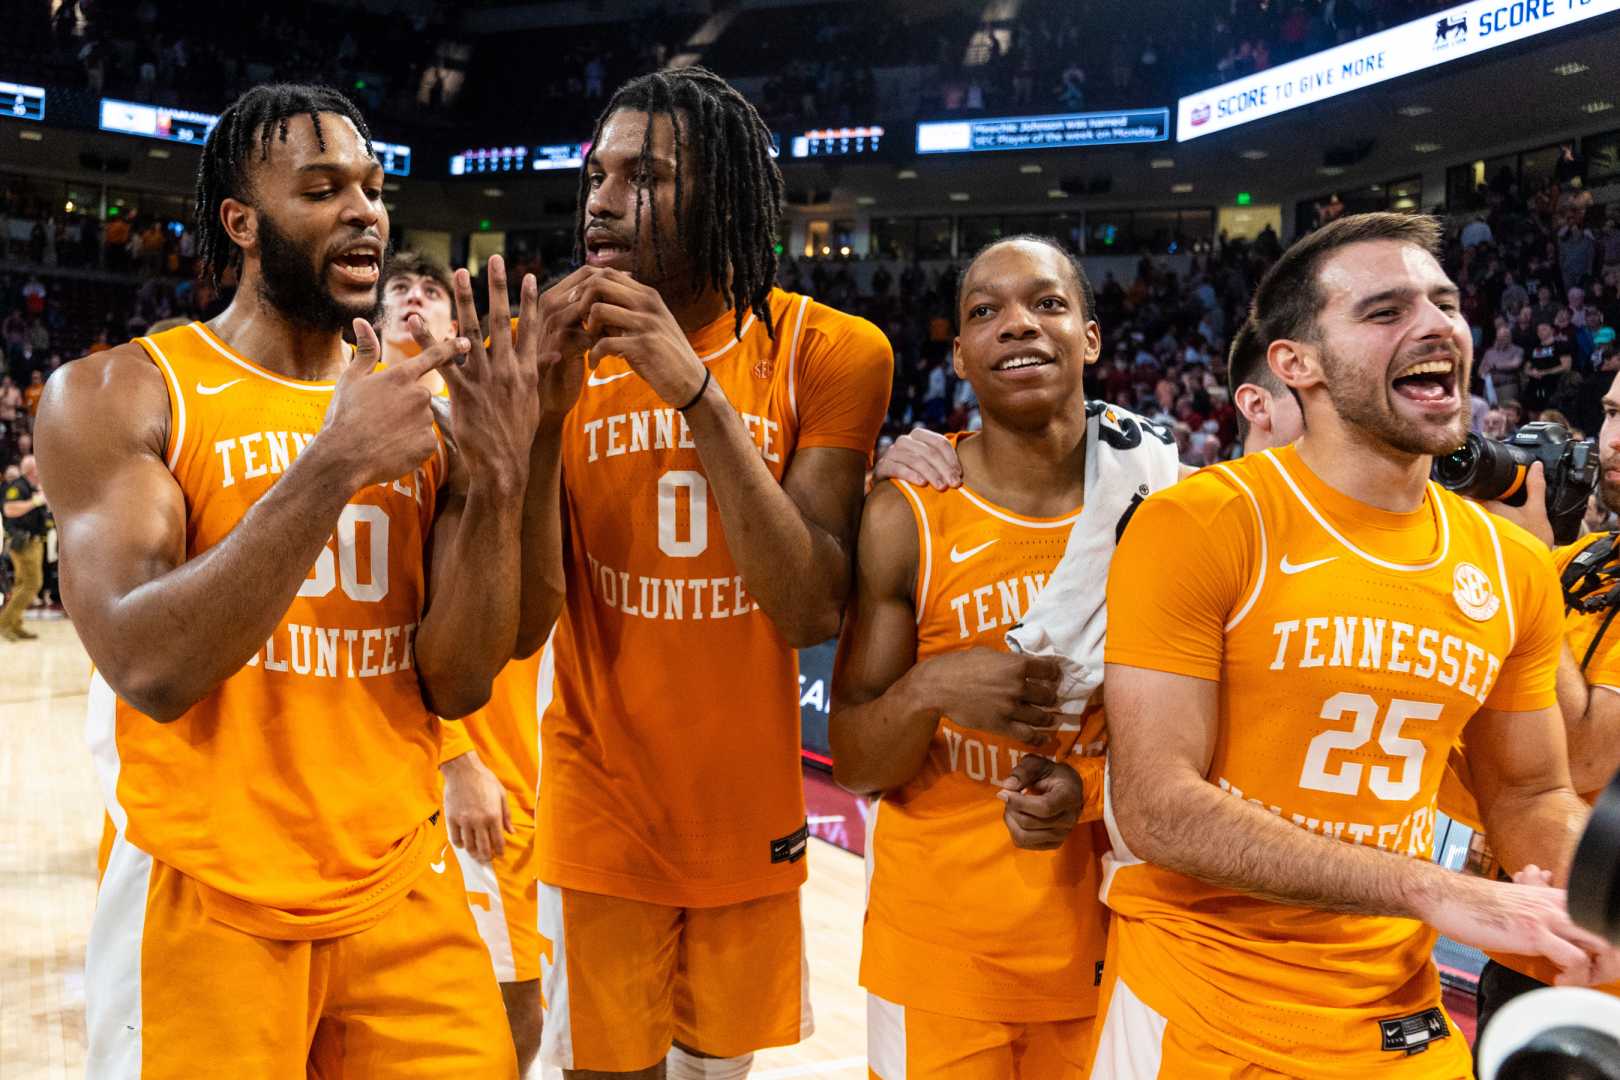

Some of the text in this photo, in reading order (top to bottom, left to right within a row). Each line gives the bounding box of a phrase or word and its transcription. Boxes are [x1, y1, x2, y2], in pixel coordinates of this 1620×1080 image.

[1479, 0, 1555, 37] SCORE
[1216, 84, 1269, 119] SCORE
[1275, 81, 1293, 101] TO
[1299, 67, 1335, 94] GIVE
[1341, 50, 1386, 80] MORE
[657, 470, 708, 558] 0
[1298, 691, 1445, 801] 25
